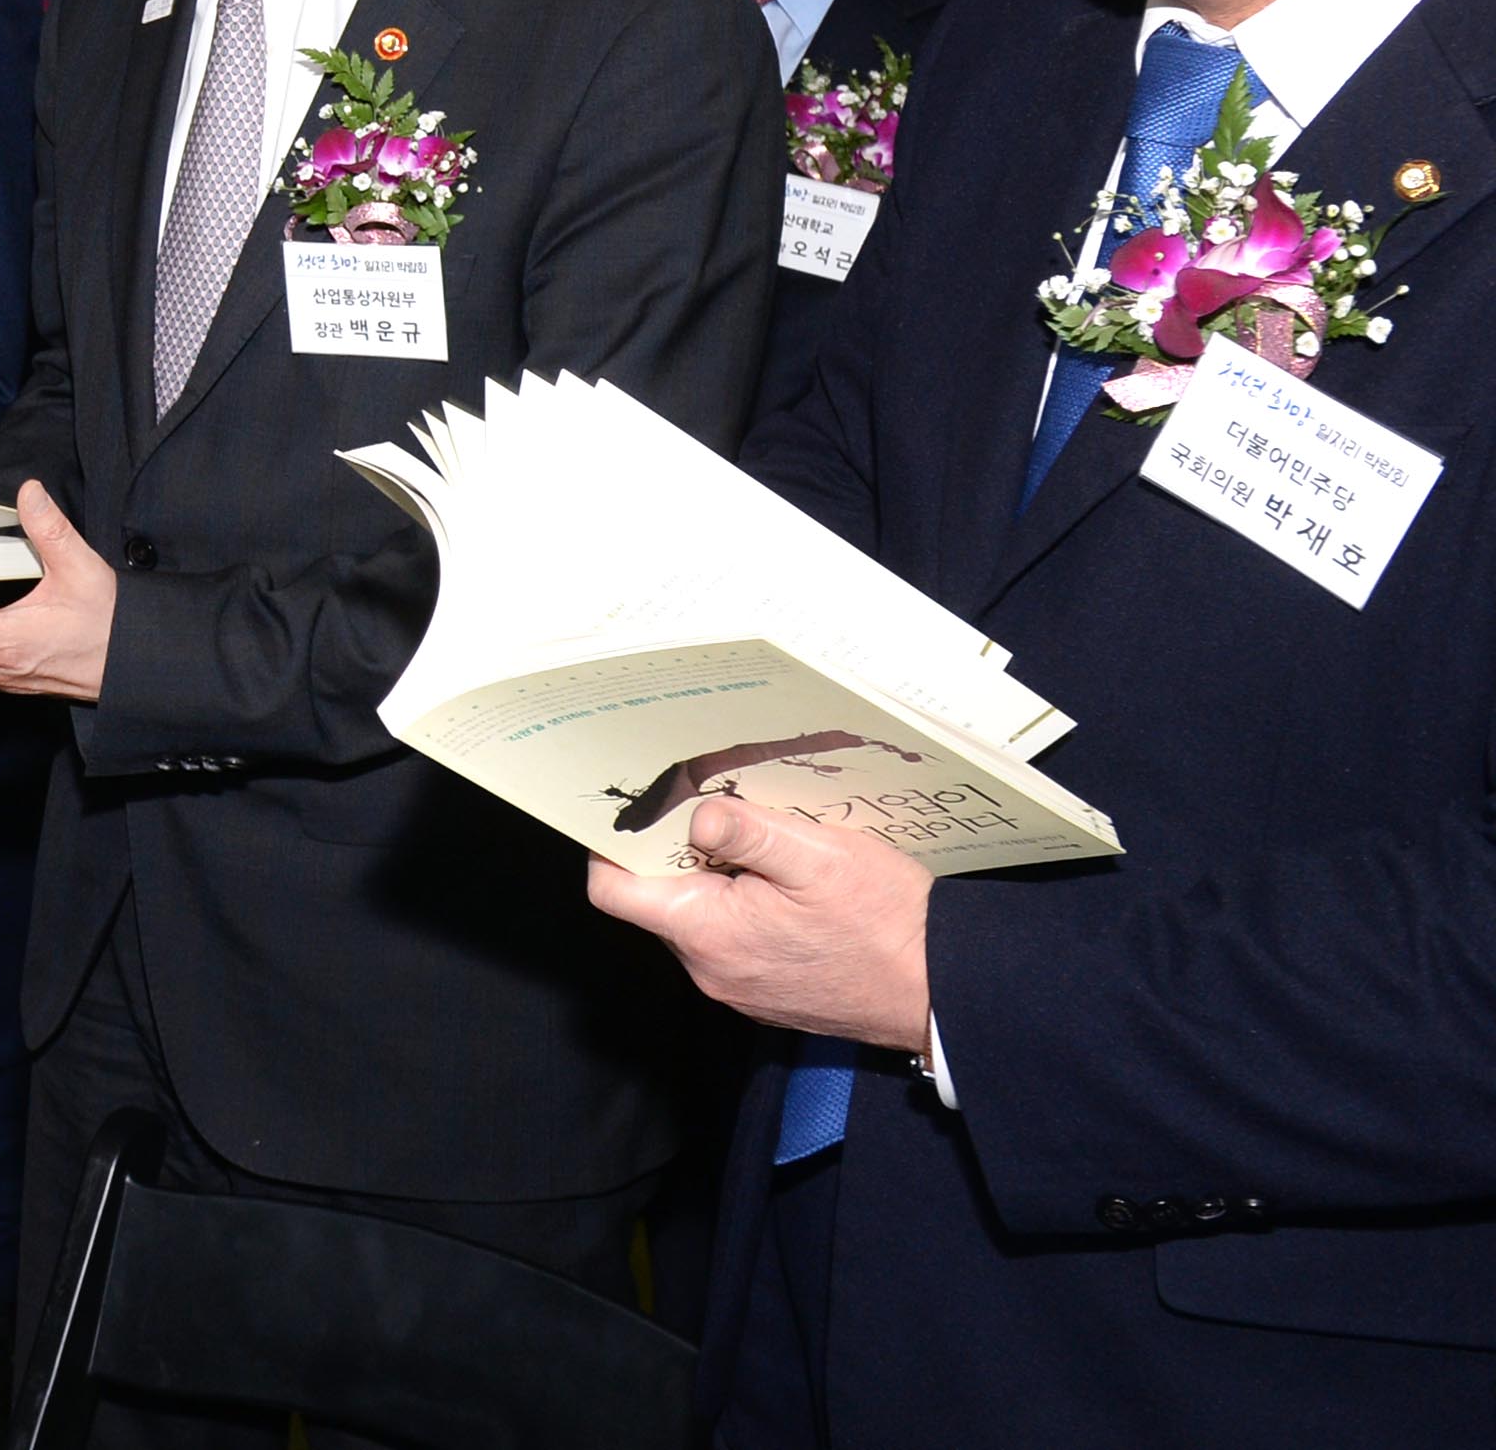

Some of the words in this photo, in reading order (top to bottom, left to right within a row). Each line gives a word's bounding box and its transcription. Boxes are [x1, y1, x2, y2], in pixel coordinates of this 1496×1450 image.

[313, 288, 417, 308] 산업통상자원부
[315, 322, 343, 339] 장관
[1170, 442, 1255, 508] 국회의원
[1227, 421, 1356, 512] 더불어민주당
